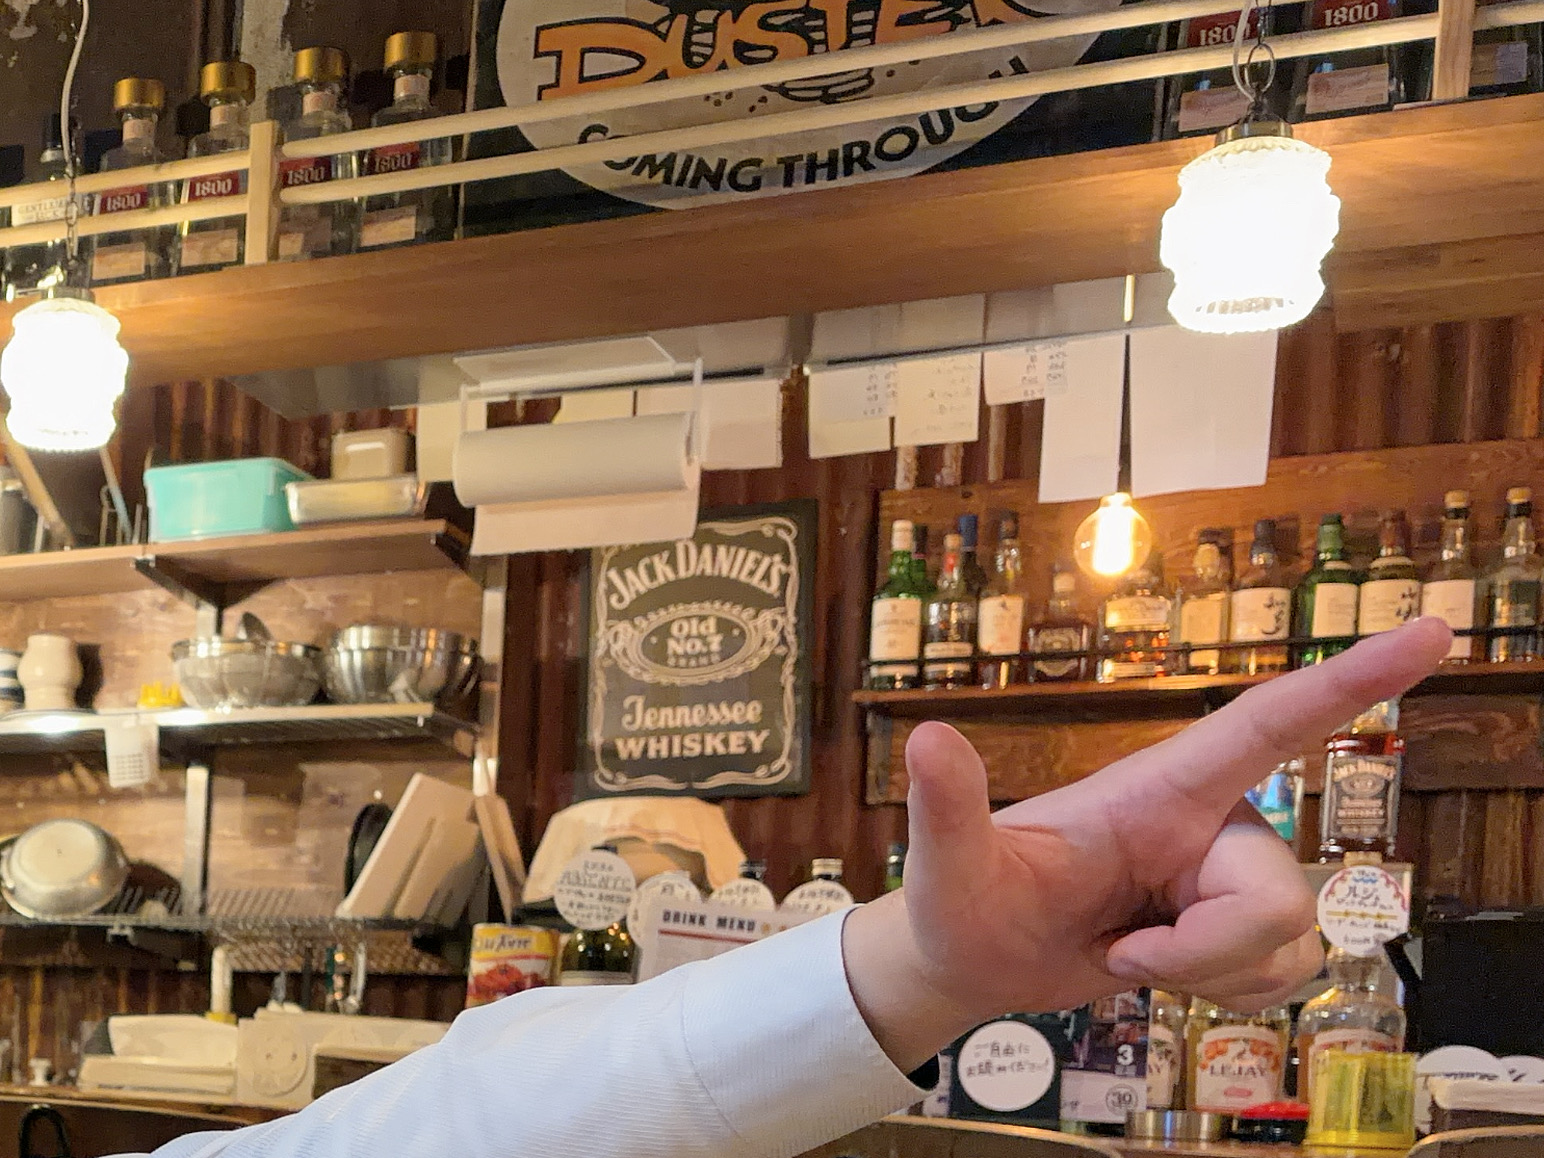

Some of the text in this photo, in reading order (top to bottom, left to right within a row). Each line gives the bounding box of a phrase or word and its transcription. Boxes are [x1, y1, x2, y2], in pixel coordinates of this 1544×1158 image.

[375, 153, 413, 173] 1800
[286, 165, 327, 186] 1800
[194, 178, 233, 197] 1800
[106, 192, 142, 212] 1800
[607, 539, 792, 610] JACK DANIEL'S
[669, 616, 717, 638] Old
[620, 694, 763, 732] Tennessee
[614, 728, 771, 761] WHISKEY
[662, 909, 757, 933] DRINK MENU
[1116, 1043, 1135, 1066] 3
